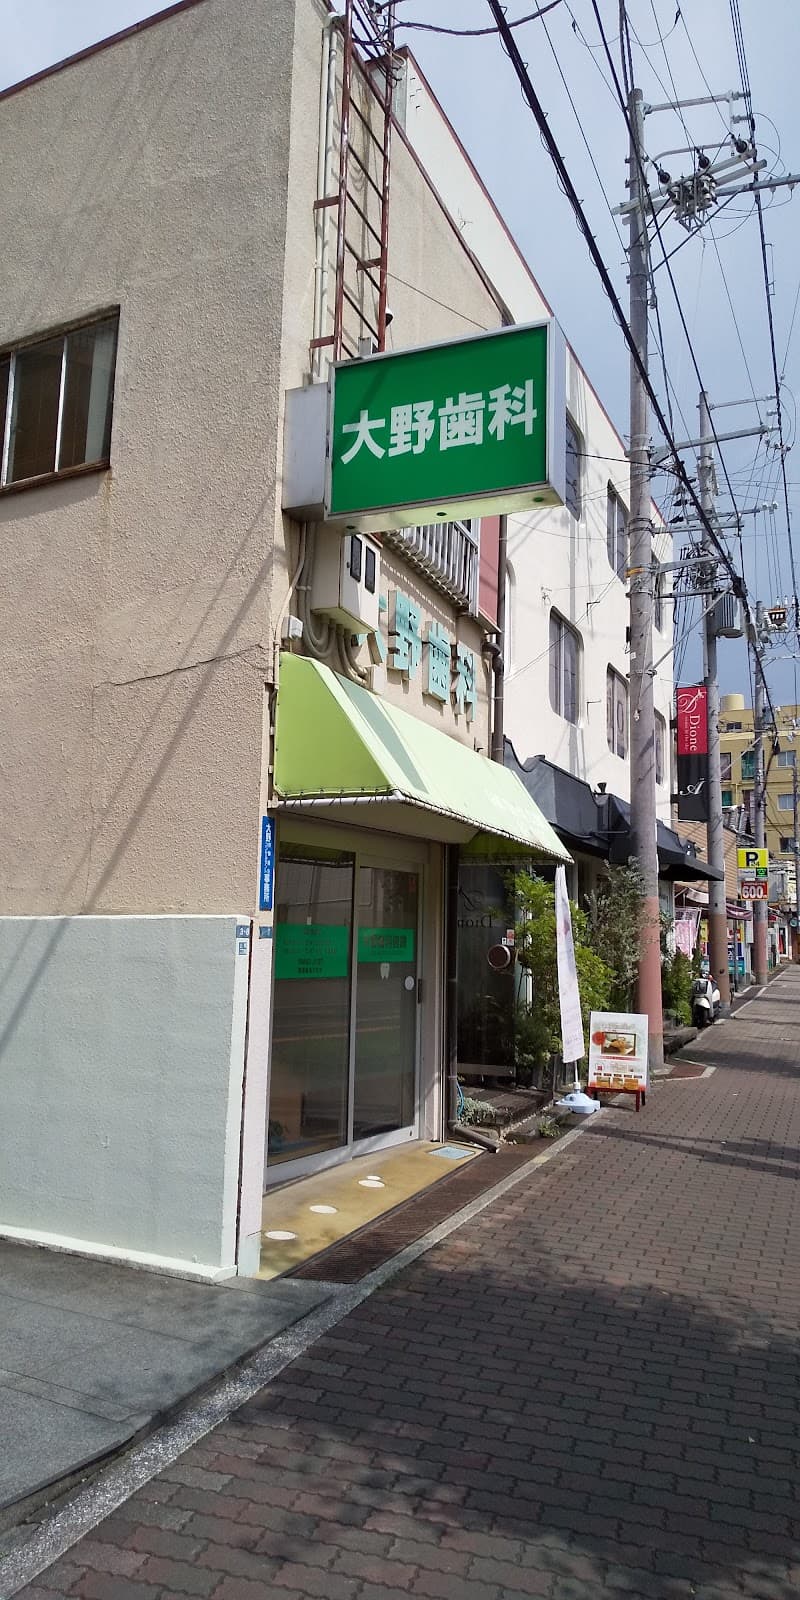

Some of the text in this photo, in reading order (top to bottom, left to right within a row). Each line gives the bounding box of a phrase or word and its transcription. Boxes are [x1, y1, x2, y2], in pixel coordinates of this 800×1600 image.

[340, 379, 537, 464] 大野歯科
[690, 714, 701, 752] Dione
[746, 852, 758, 866] P
[743, 886, 763, 898] 600
